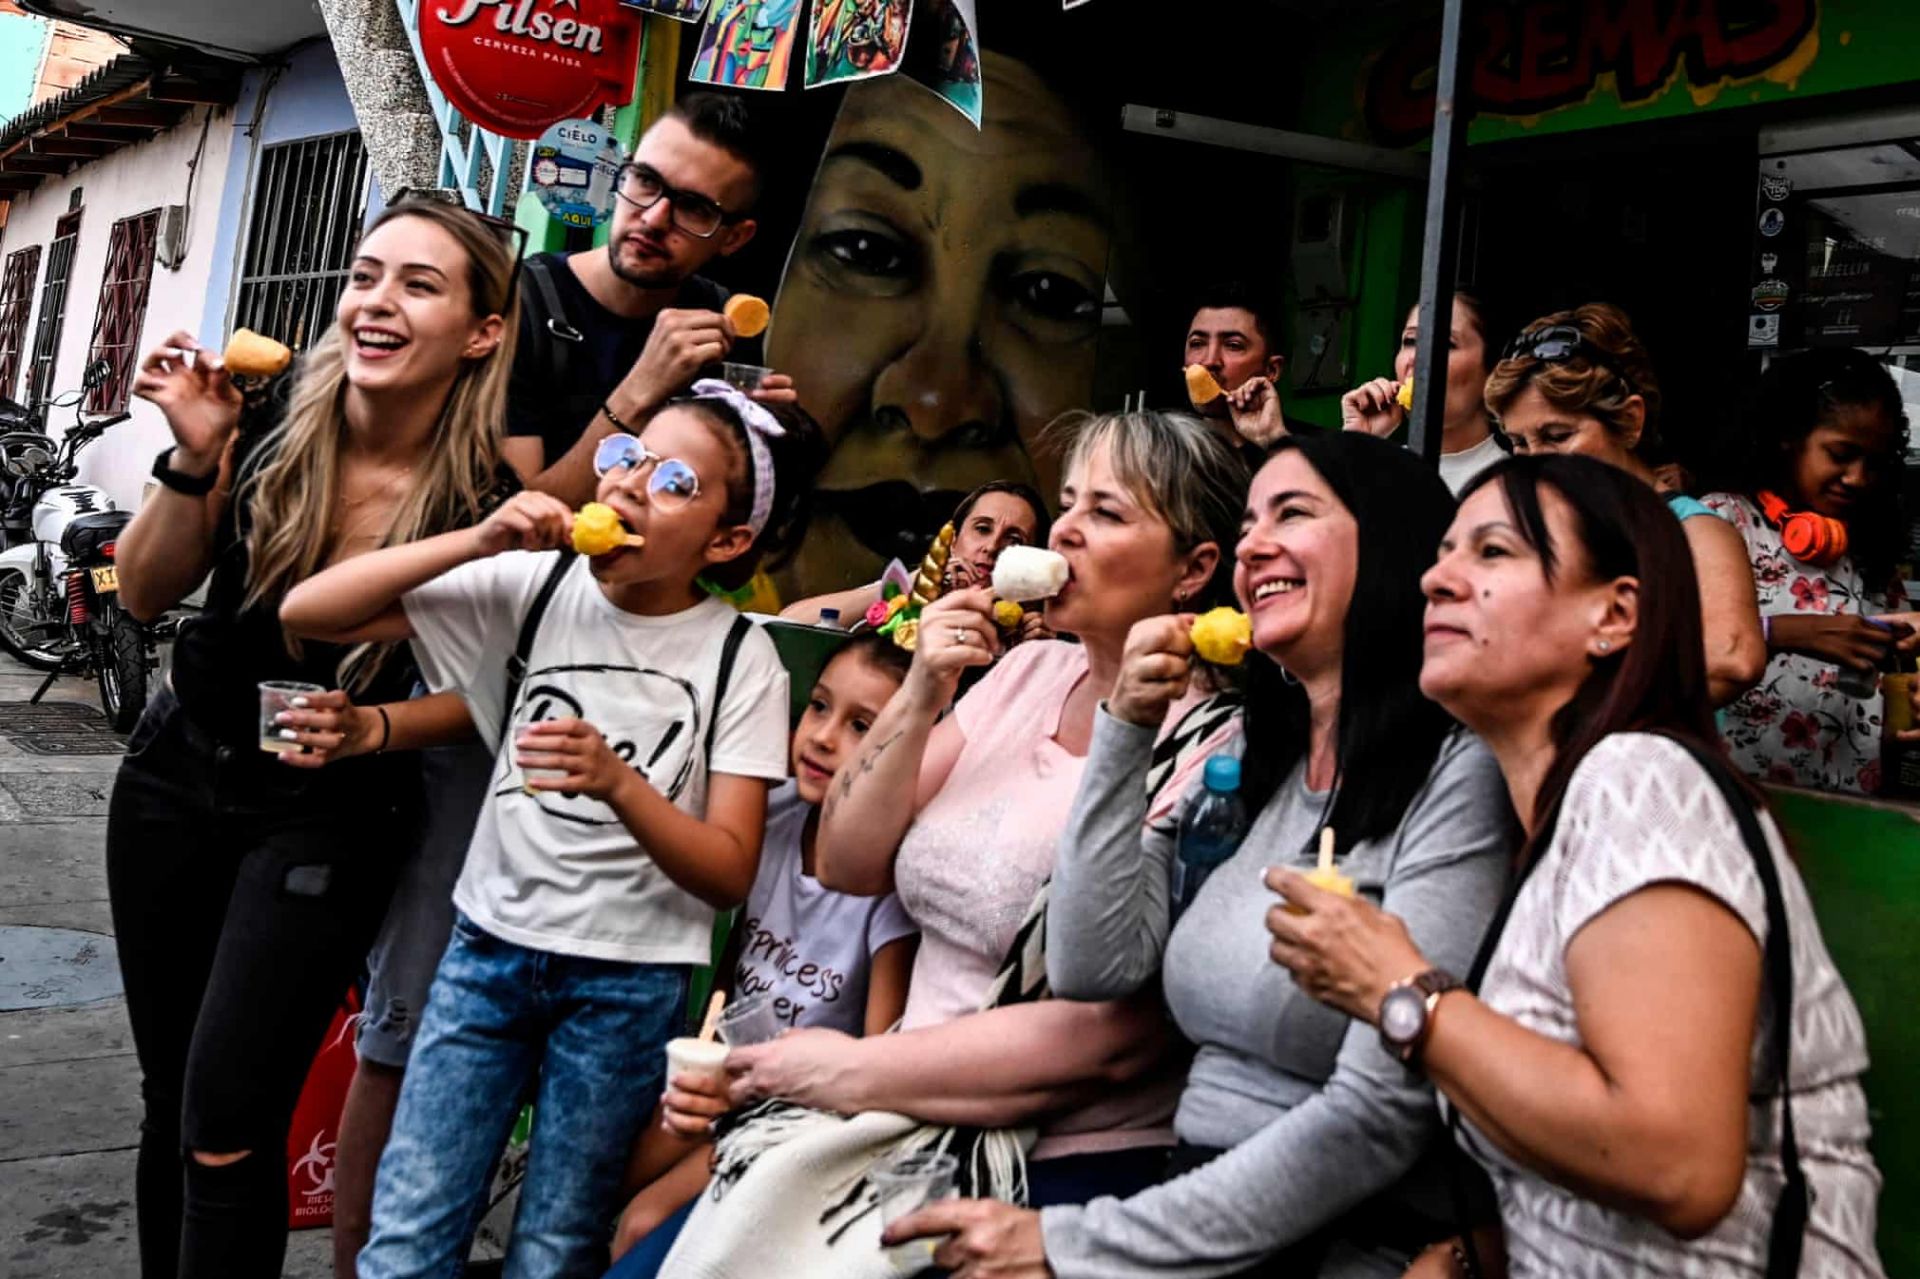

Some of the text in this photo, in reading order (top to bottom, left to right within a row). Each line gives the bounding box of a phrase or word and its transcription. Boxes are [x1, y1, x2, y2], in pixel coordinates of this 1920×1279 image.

[473, 36, 582, 68] CERVEZA PAISA
[557, 125, 598, 145] CIELO
